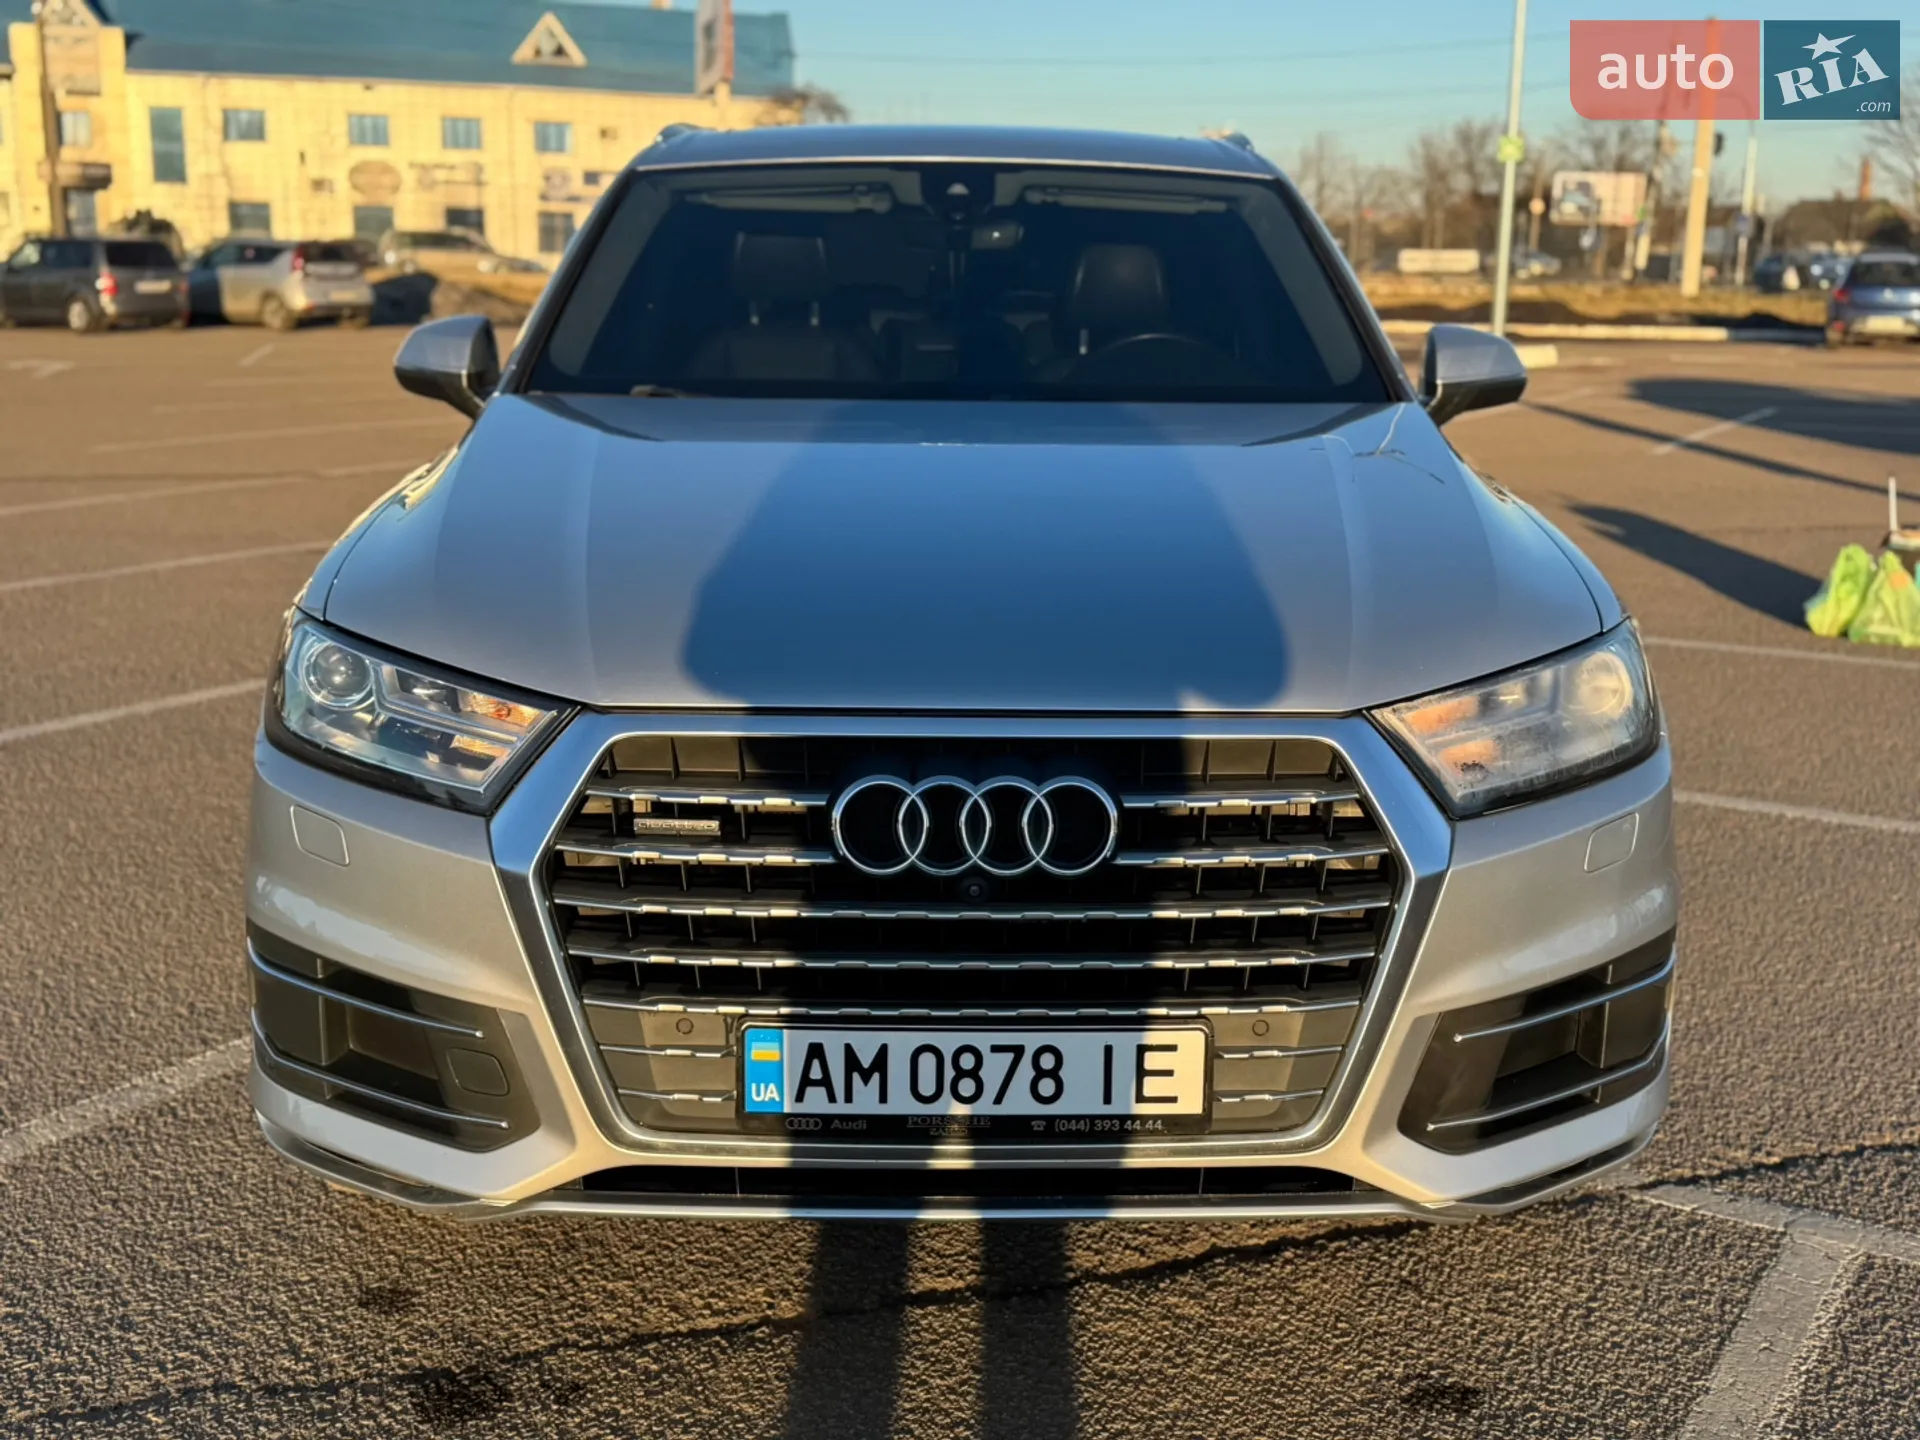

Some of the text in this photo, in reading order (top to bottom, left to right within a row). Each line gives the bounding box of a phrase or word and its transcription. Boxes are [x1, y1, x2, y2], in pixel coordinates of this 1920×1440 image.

[794, 1042, 1179, 1105] AM 0878 IE
[751, 1083, 780, 1102] UA
[830, 1118, 868, 1130] Audi
[1054, 1118, 1163, 1132] (044) 393 44 44
